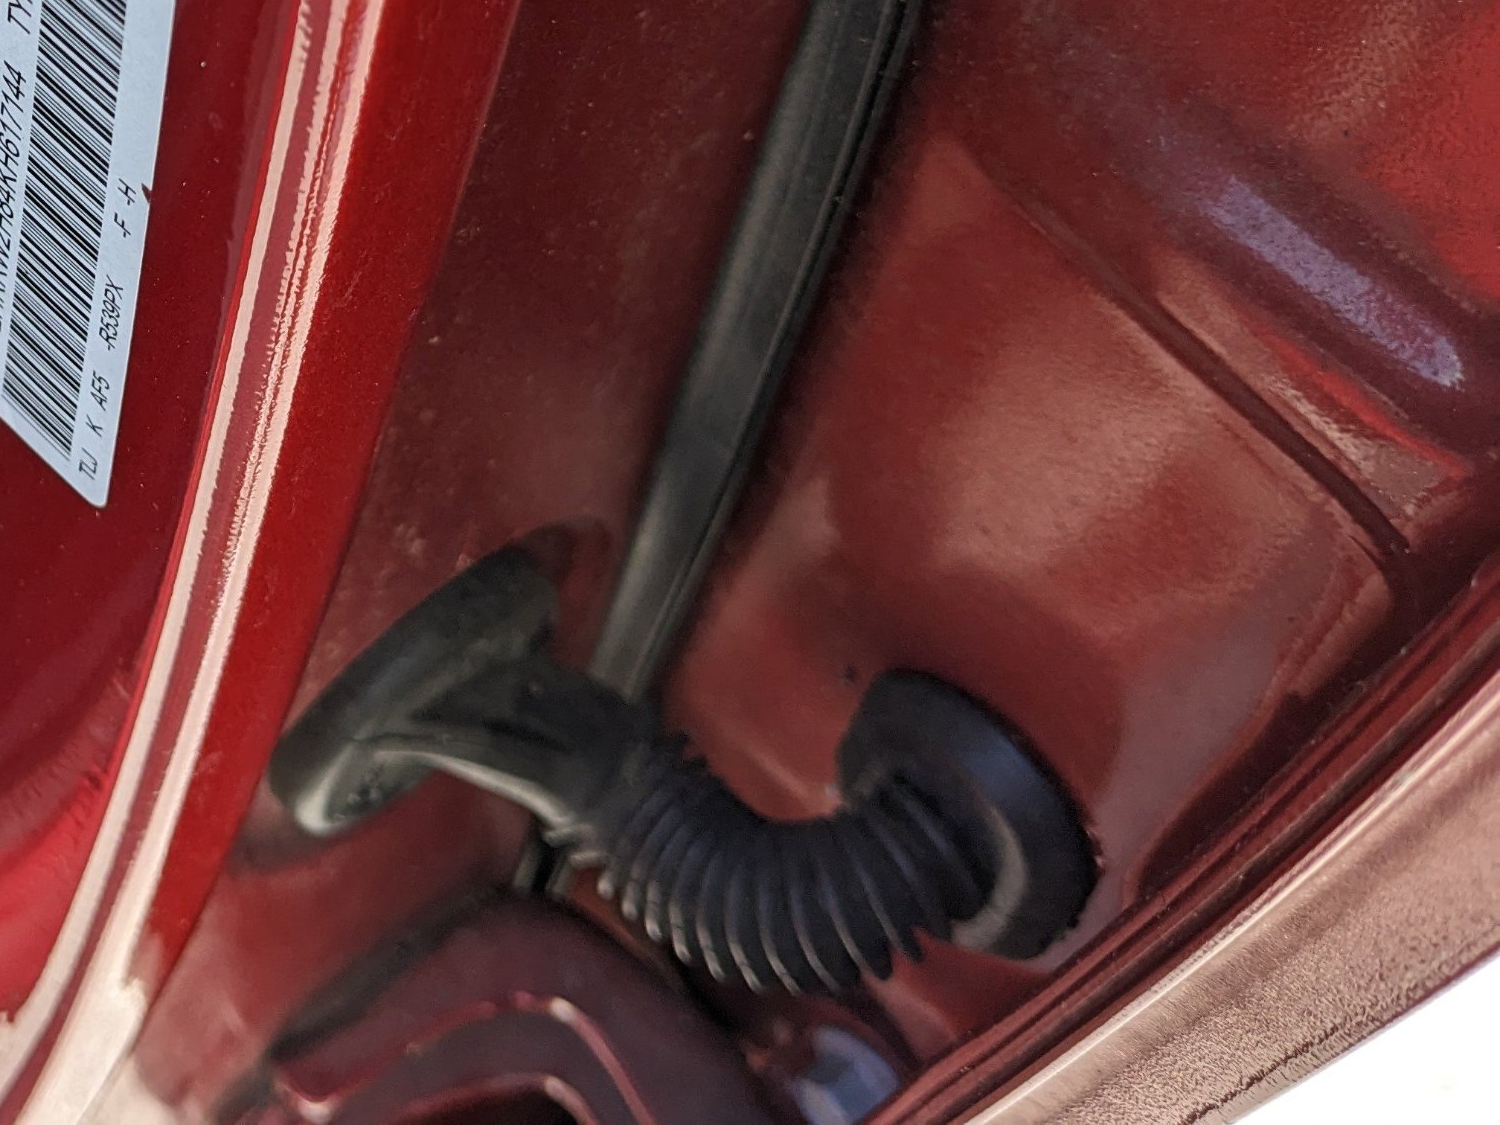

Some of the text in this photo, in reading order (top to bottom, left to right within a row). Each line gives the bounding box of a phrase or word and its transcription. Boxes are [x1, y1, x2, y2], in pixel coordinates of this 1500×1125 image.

[77, 177, 136, 480] TLJ K AF5 -R539PX -F -H
